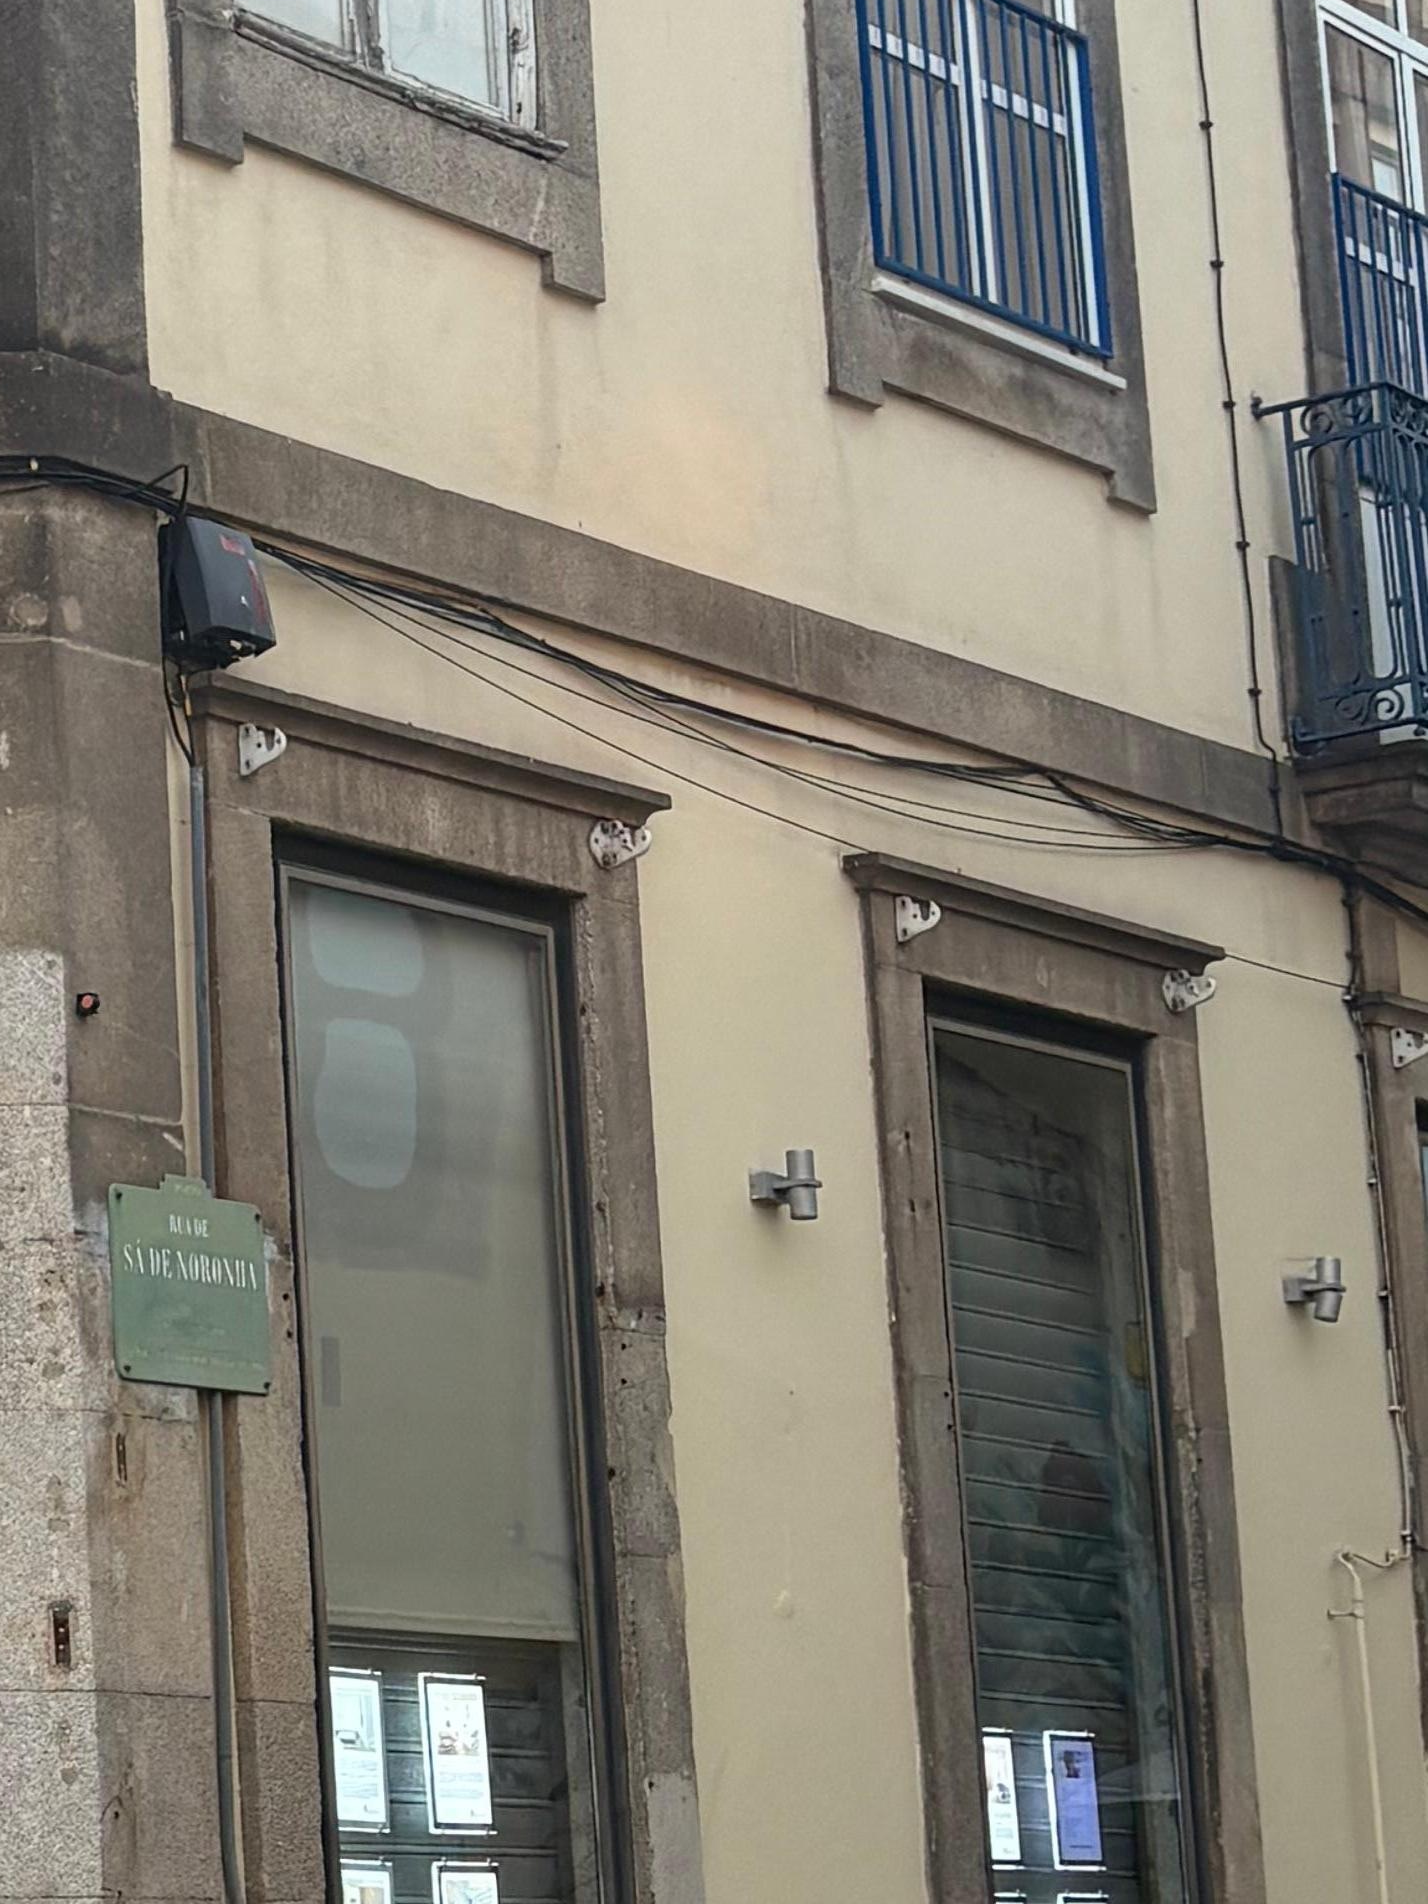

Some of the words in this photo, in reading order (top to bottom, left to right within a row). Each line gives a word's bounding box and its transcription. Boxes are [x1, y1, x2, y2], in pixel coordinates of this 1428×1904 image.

[168, 1214, 192, 1236] RUA
[193, 1218, 209, 1238] DE
[123, 1239, 144, 1274] SÁ
[149, 1247, 172, 1279] DE
[176, 1250, 257, 1291] NORONHA
